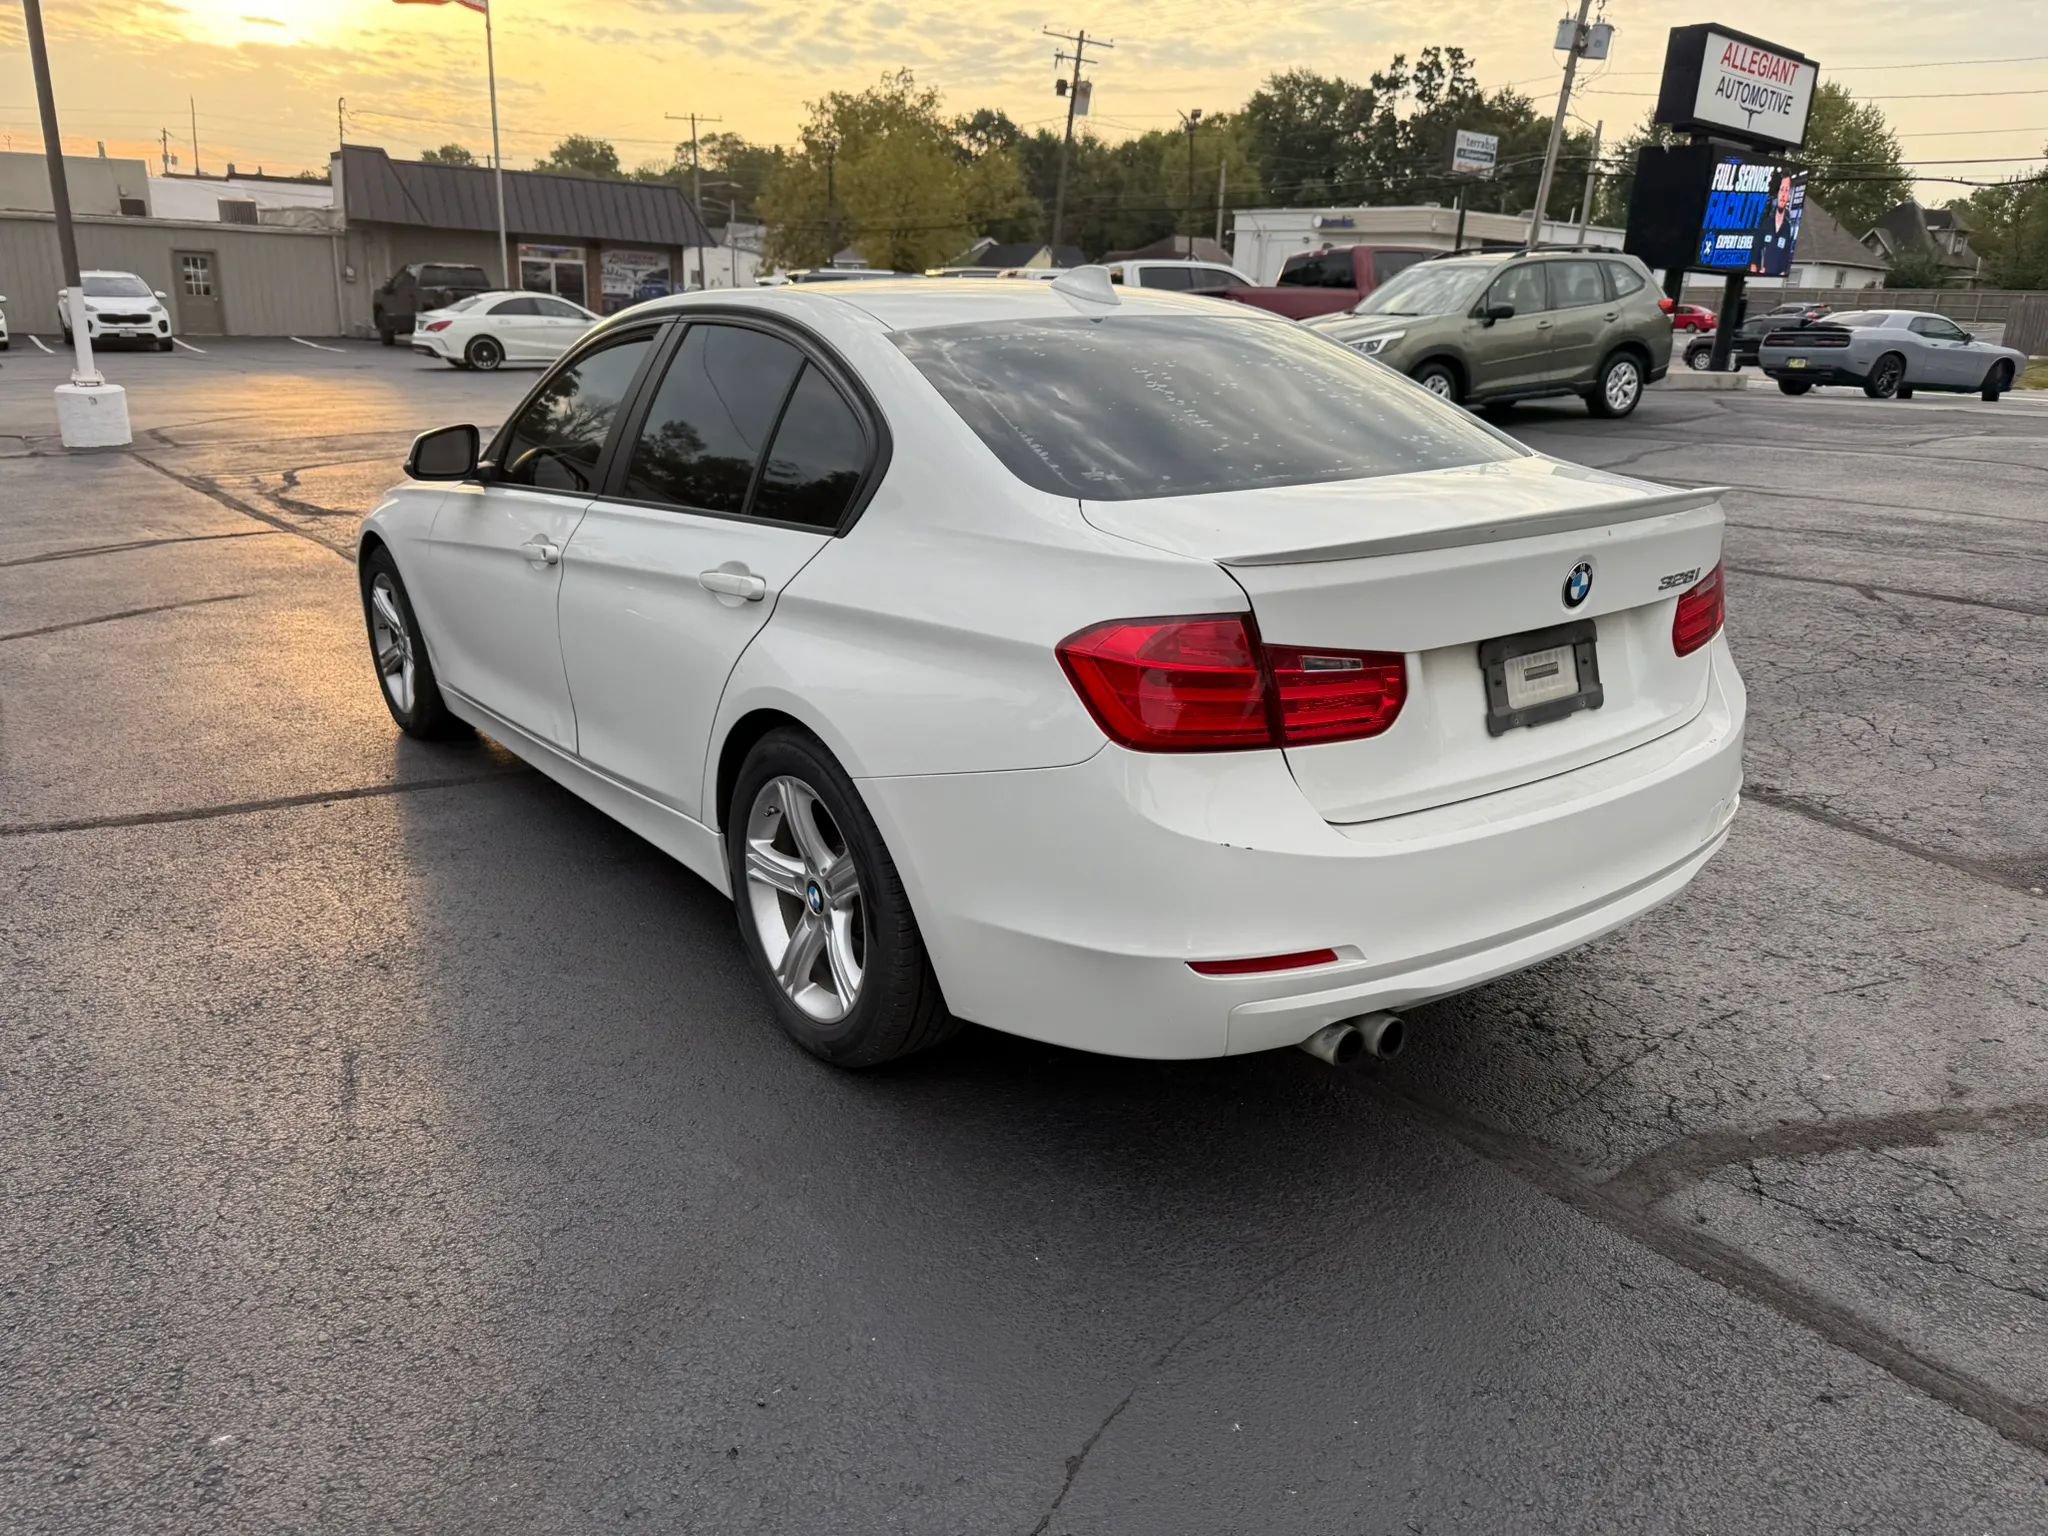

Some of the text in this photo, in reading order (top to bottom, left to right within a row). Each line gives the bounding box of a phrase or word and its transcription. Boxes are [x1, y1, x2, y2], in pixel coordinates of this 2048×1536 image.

[1720, 42, 1799, 86] ALLEGIANT
[1715, 76, 1793, 115] AUTOMOTIVE
[1711, 163, 1775, 192] FULL SERVICE
[1703, 191, 1770, 230] FACILITY
[1715, 234, 1754, 249] EXPERT LEVEL
